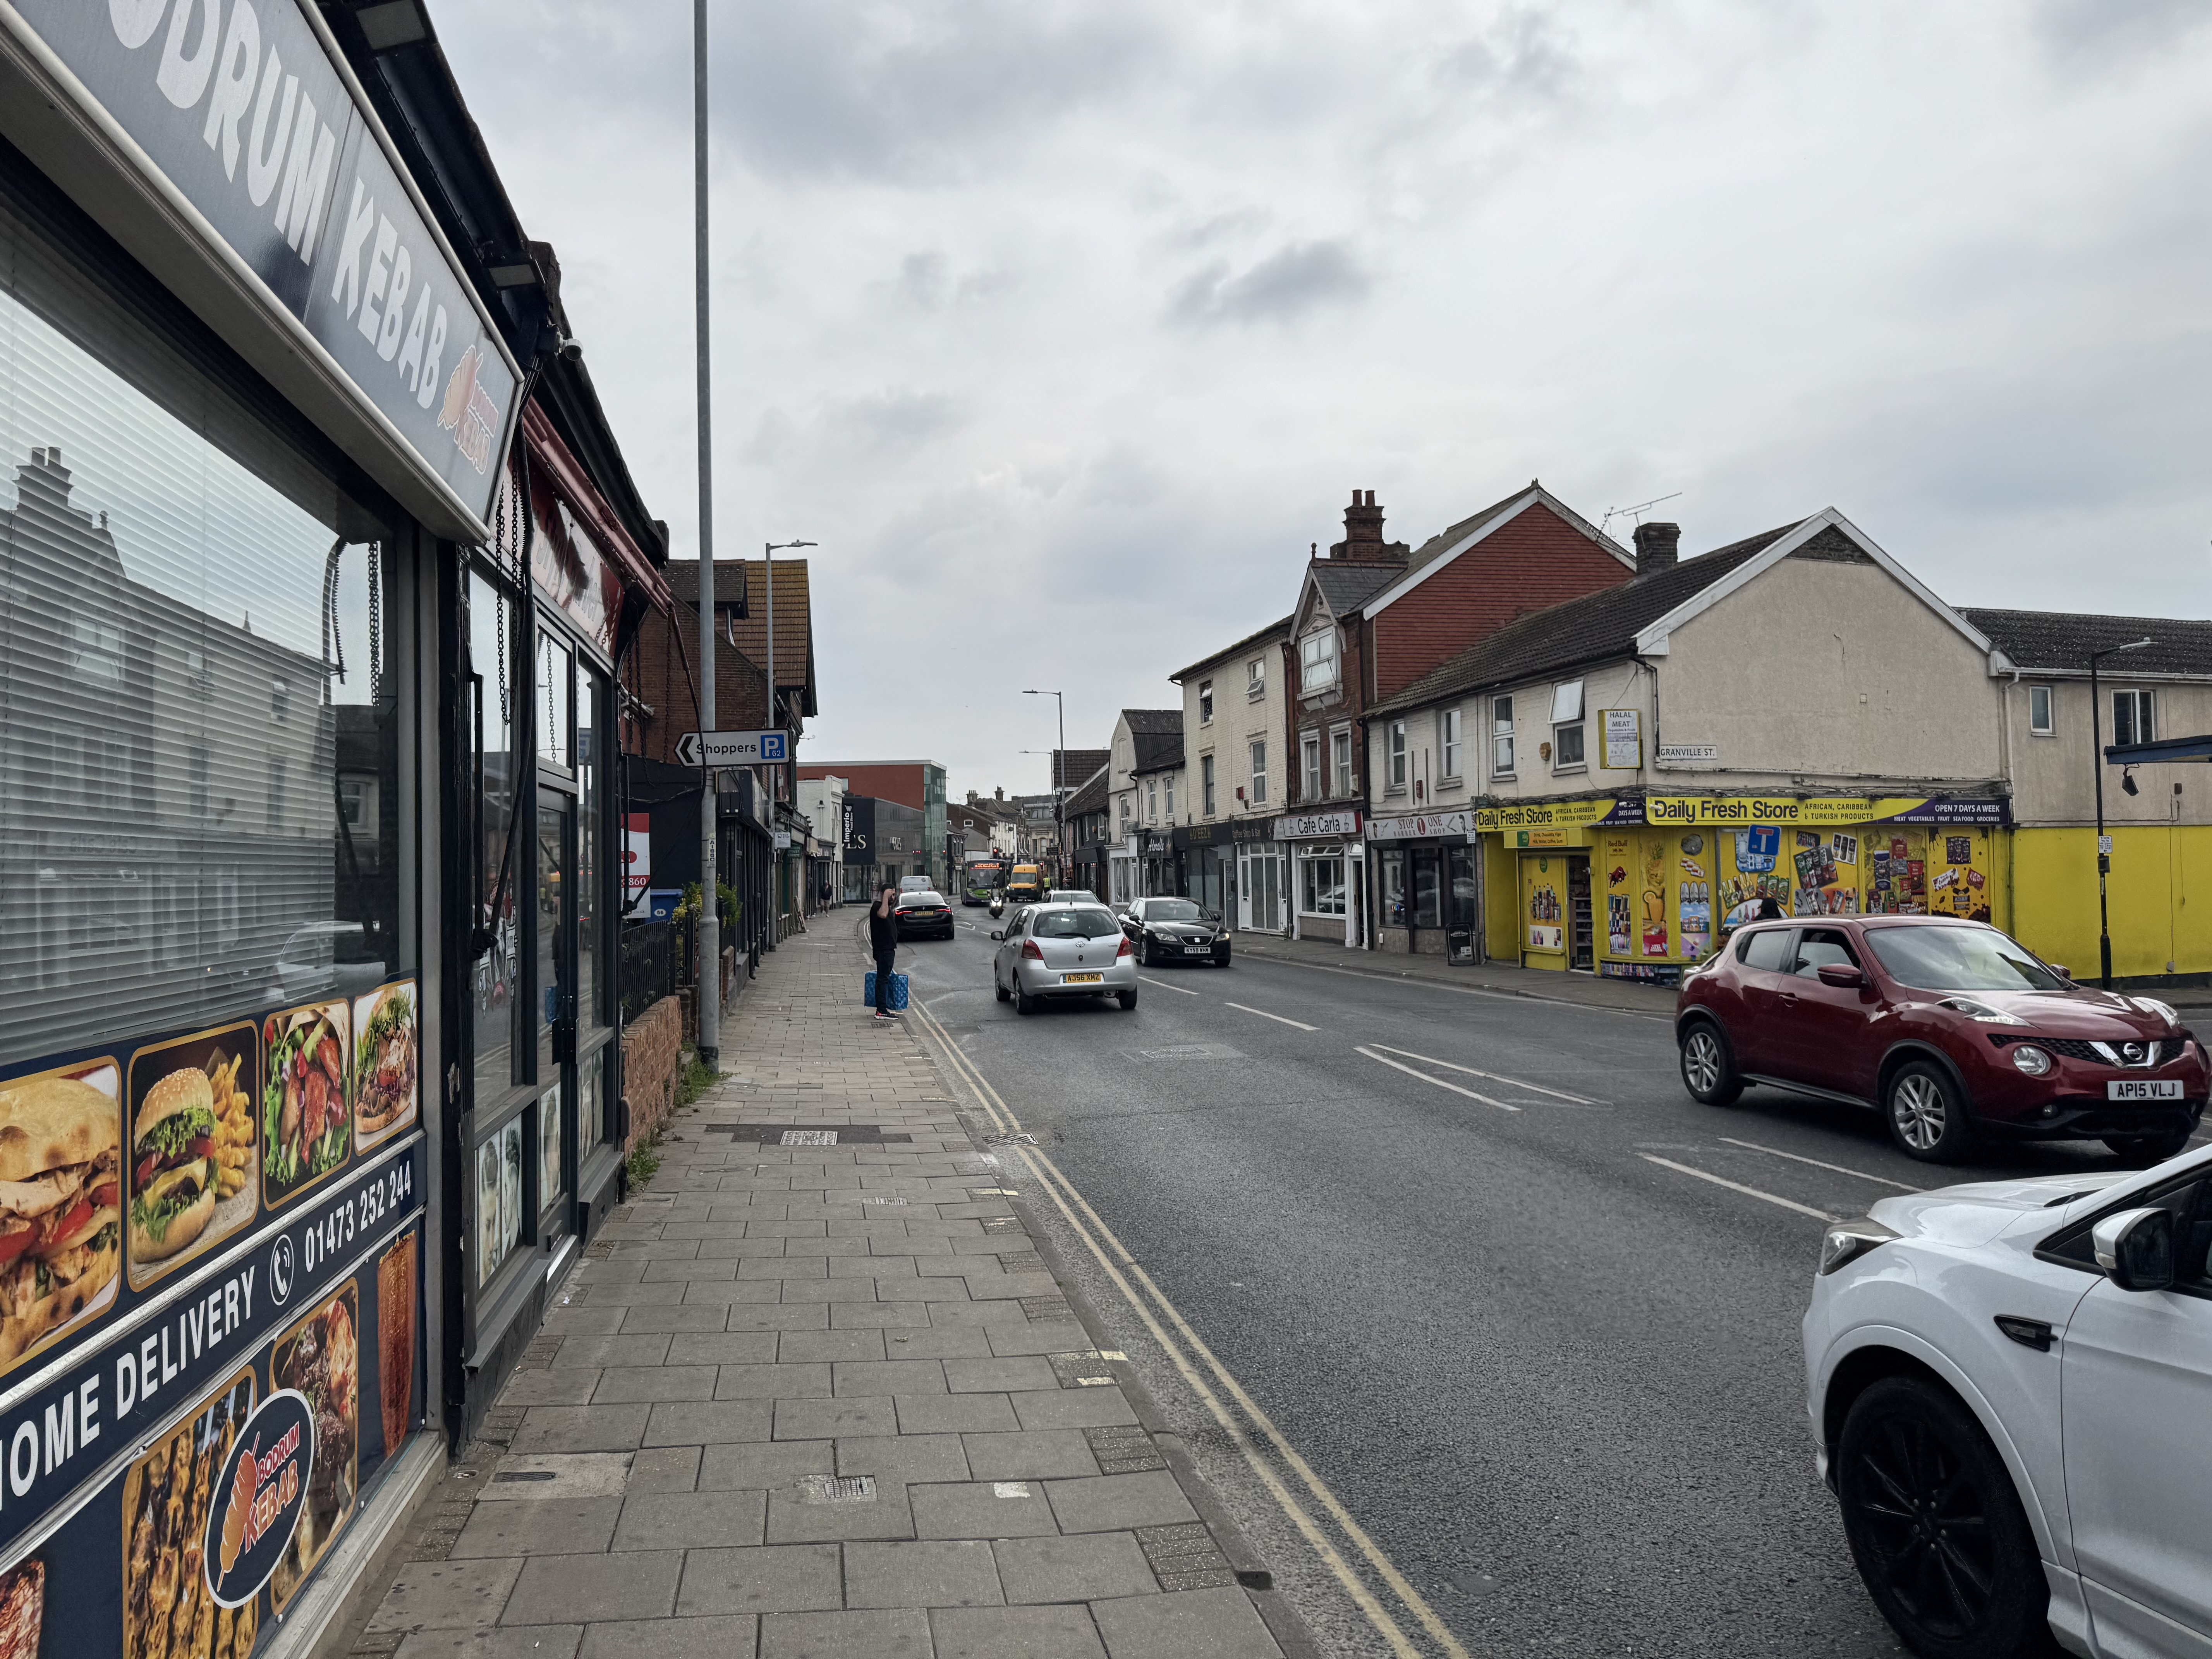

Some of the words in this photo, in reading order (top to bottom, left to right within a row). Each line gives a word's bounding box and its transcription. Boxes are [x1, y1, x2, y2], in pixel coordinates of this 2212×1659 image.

[108, 0, 335, 266] DRUM
[331, 176, 447, 409] KEBAB
[696, 744, 756, 755] Shoppers
[1398, 818, 1413, 829] STOP
[1428, 816, 1443, 827] ONE
[1478, 810, 1498, 830] Daily
[1501, 809, 1524, 825] Fresh
[1526, 808, 1553, 824] Store
[1655, 800, 1695, 823] Daily
[1701, 800, 1747, 818] Fresh
[1752, 800, 1798, 818] Store
[1298, 817, 1316, 834] Cafe
[1318, 815, 1340, 833] Carla
[2117, 1083, 2146, 1097] AP15
[2150, 1082, 2176, 1097] VLJ
[305, 1200, 354, 1273] 01473
[360, 1178, 385, 1231] 252
[390, 1160, 411, 1209] 244
[0, 1374, 99, 1511] OME
[117, 1265, 255, 1420] DELIVERY
[258, 1420, 300, 1489] BODRUM
[246, 1459, 299, 1555] KEBAB
